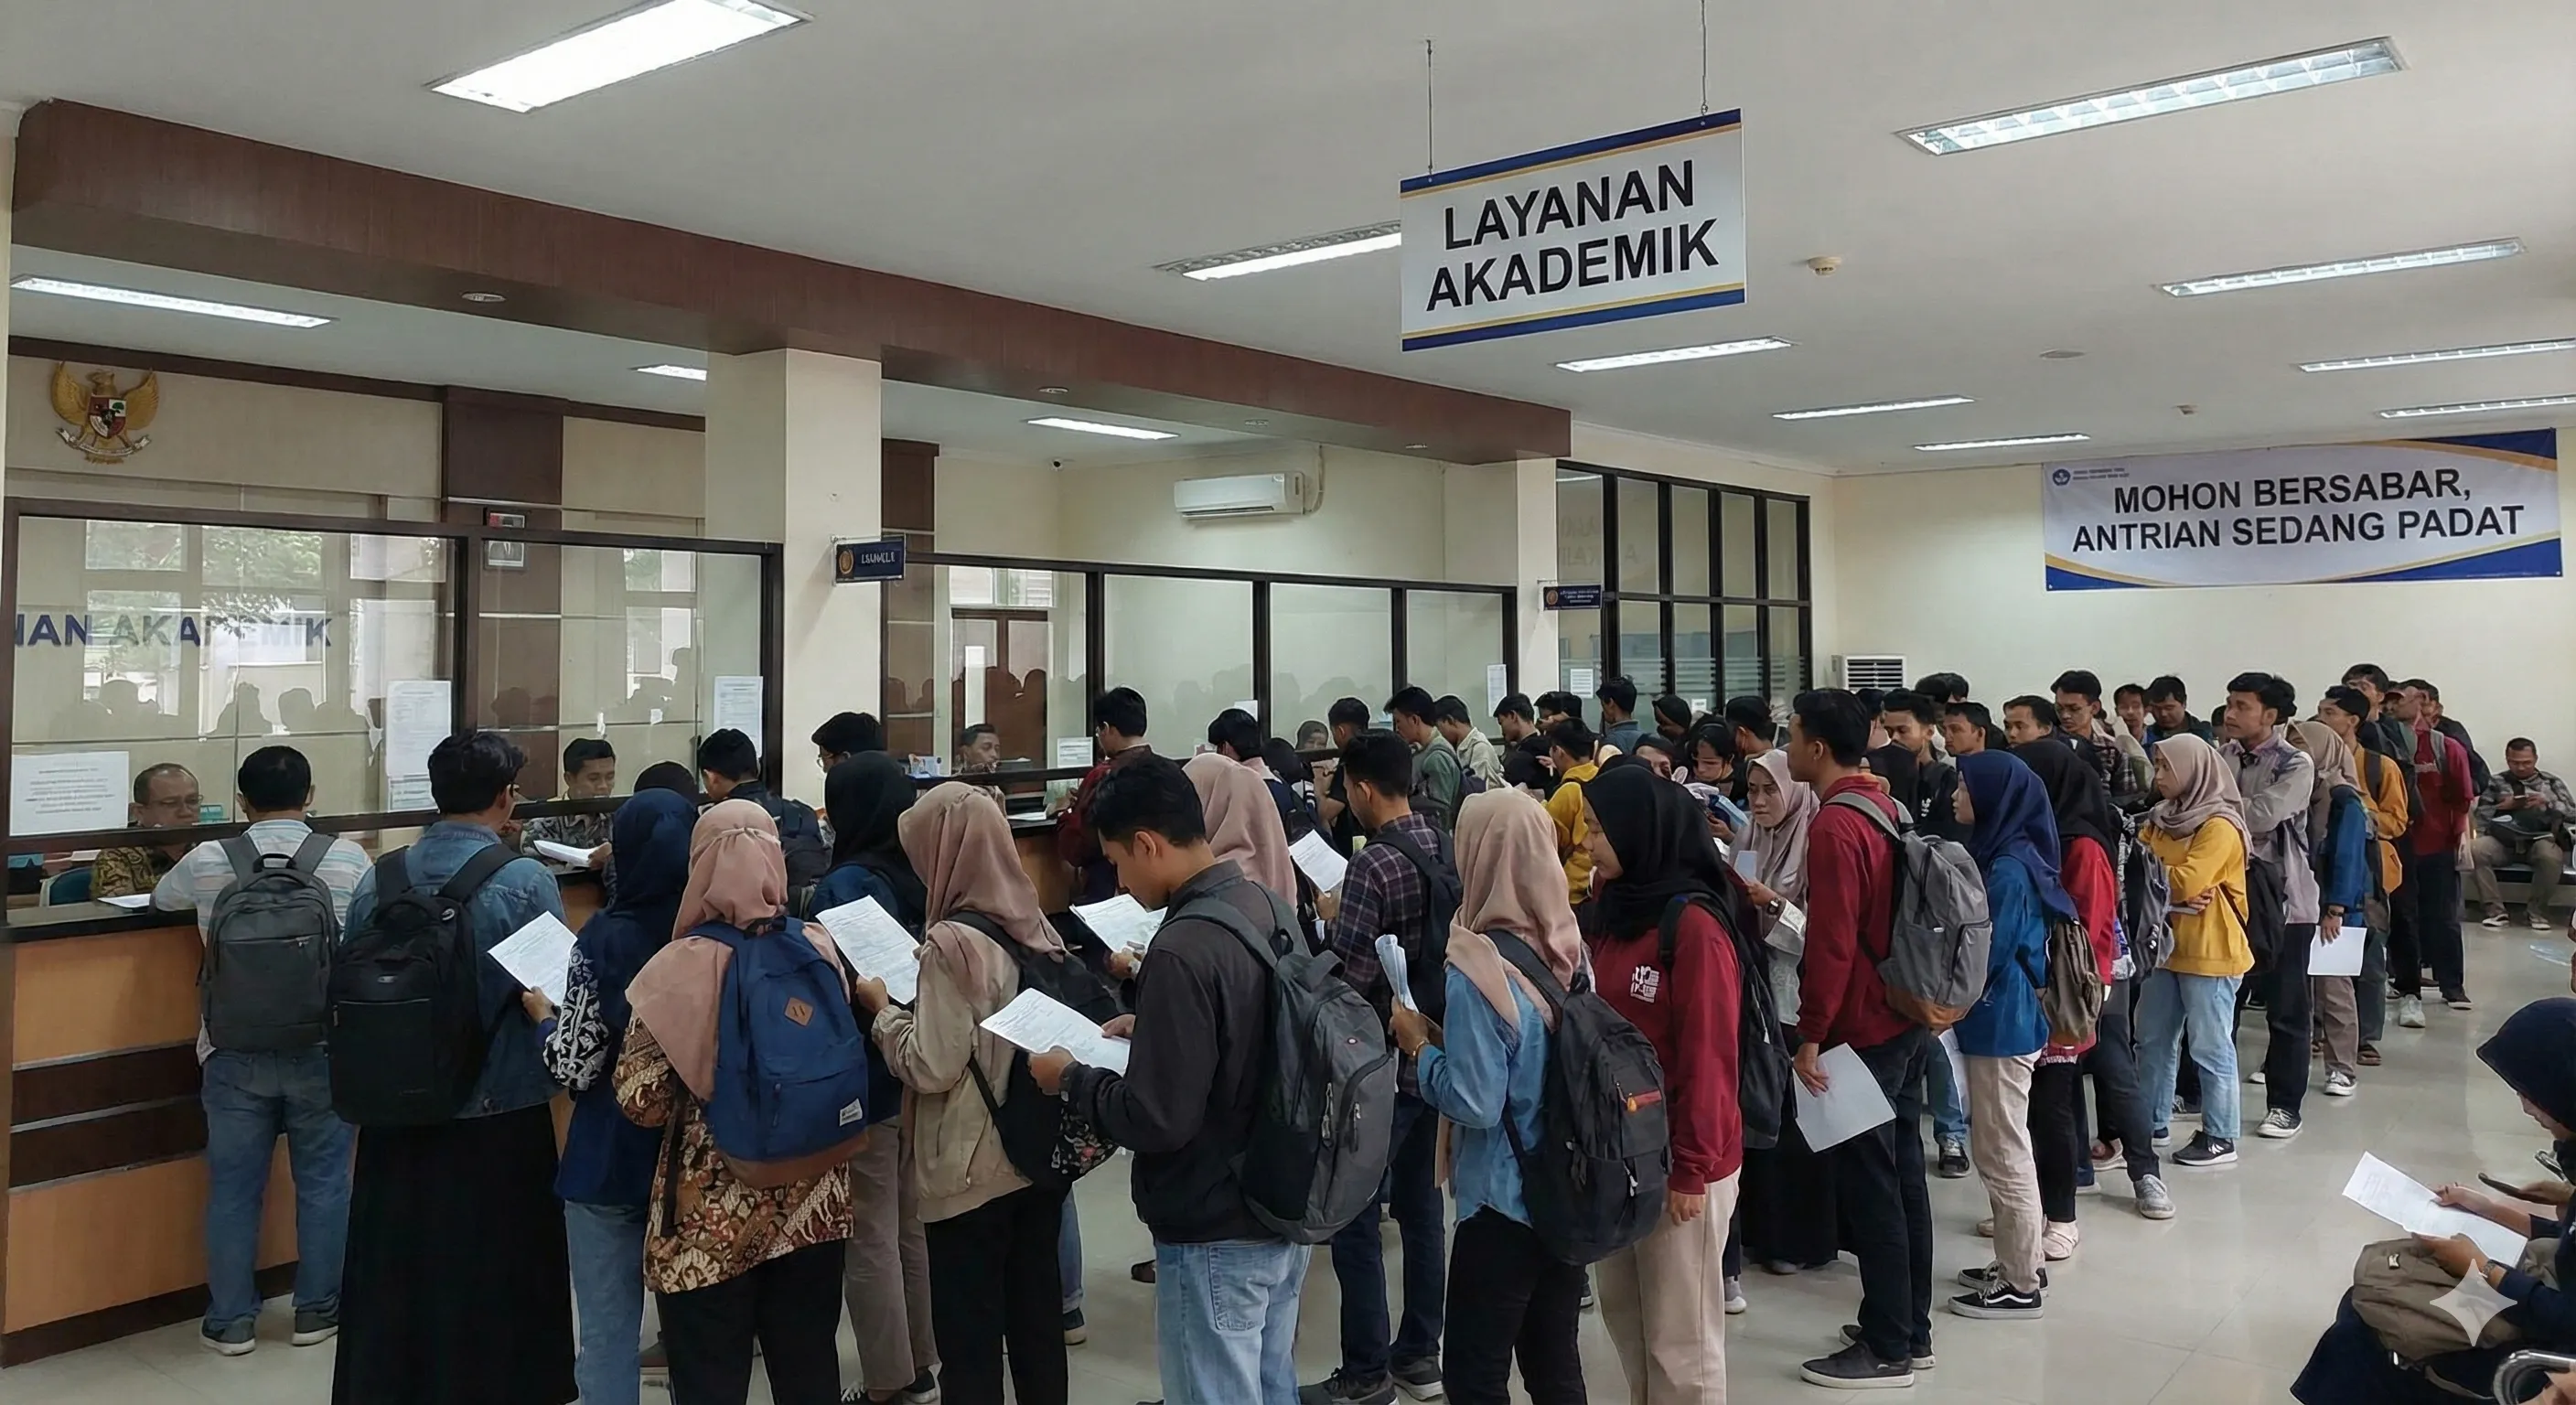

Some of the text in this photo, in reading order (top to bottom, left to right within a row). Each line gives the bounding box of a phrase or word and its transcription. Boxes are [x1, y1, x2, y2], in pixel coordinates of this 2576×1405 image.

[1444, 159, 1693, 251] LAYANAN
[1426, 218, 1719, 312] AKADEMIK
[2114, 468, 2471, 514] MOHON BERSABAR,
[2072, 505, 2525, 552] ANTRIAN SEDANG PADAT
